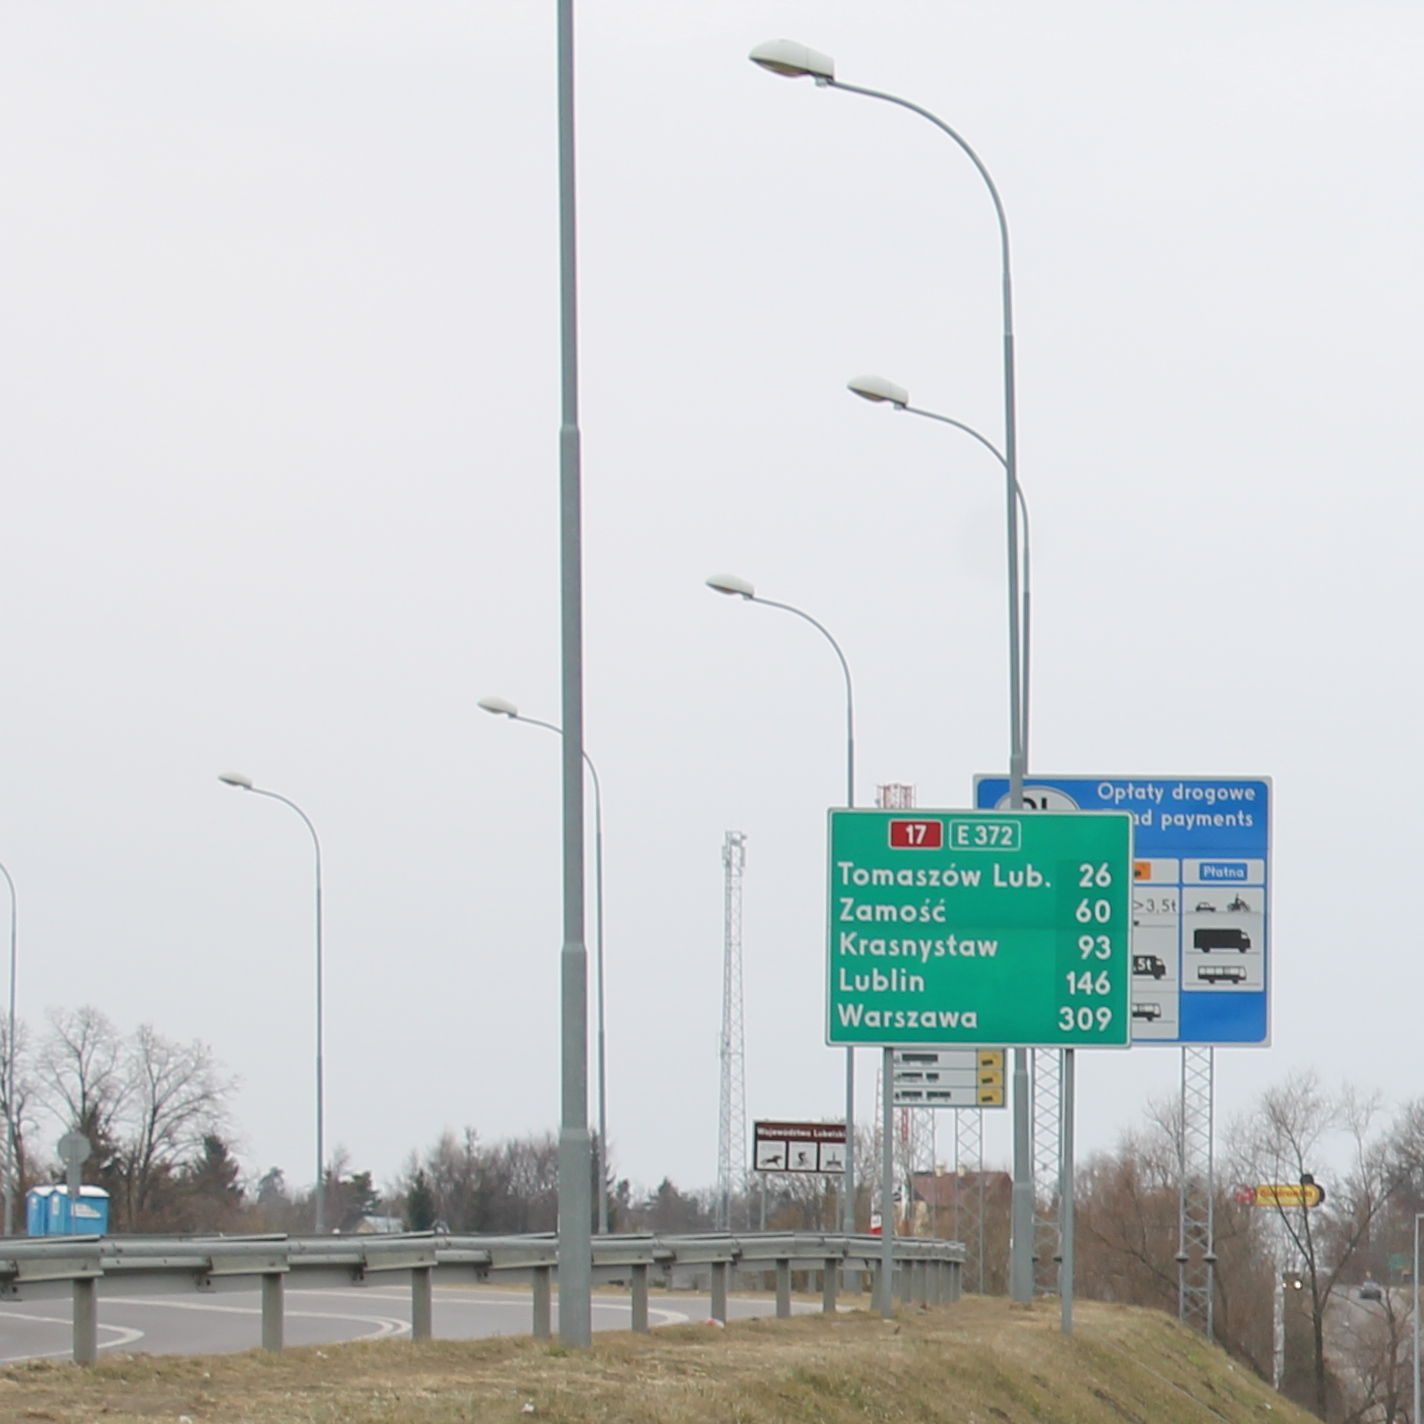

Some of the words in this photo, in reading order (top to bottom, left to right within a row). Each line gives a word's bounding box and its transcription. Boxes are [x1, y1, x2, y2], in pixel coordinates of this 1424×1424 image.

[1097, 782, 1164, 805] Opłaty
[1171, 783, 1256, 805] drogowe
[1160, 812, 1254, 831] payments
[905, 825, 928, 845] 17
[957, 826, 969, 845] E
[974, 825, 1013, 846] 372
[837, 861, 981, 887] Tomaszów
[993, 863, 1052, 888] Lub.
[1079, 863, 1112, 888] 26
[1203, 865, 1245, 879] Płatna
[839, 897, 947, 922] Zamość
[1075, 898, 1112, 923] 60
[839, 932, 999, 963] Krasnystaw
[1077, 935, 1112, 960] 93
[839, 968, 925, 992] Lublin
[1066, 970, 1112, 995] 146
[837, 1003, 979, 1028] Warszawa
[1058, 1006, 1113, 1031] 309
